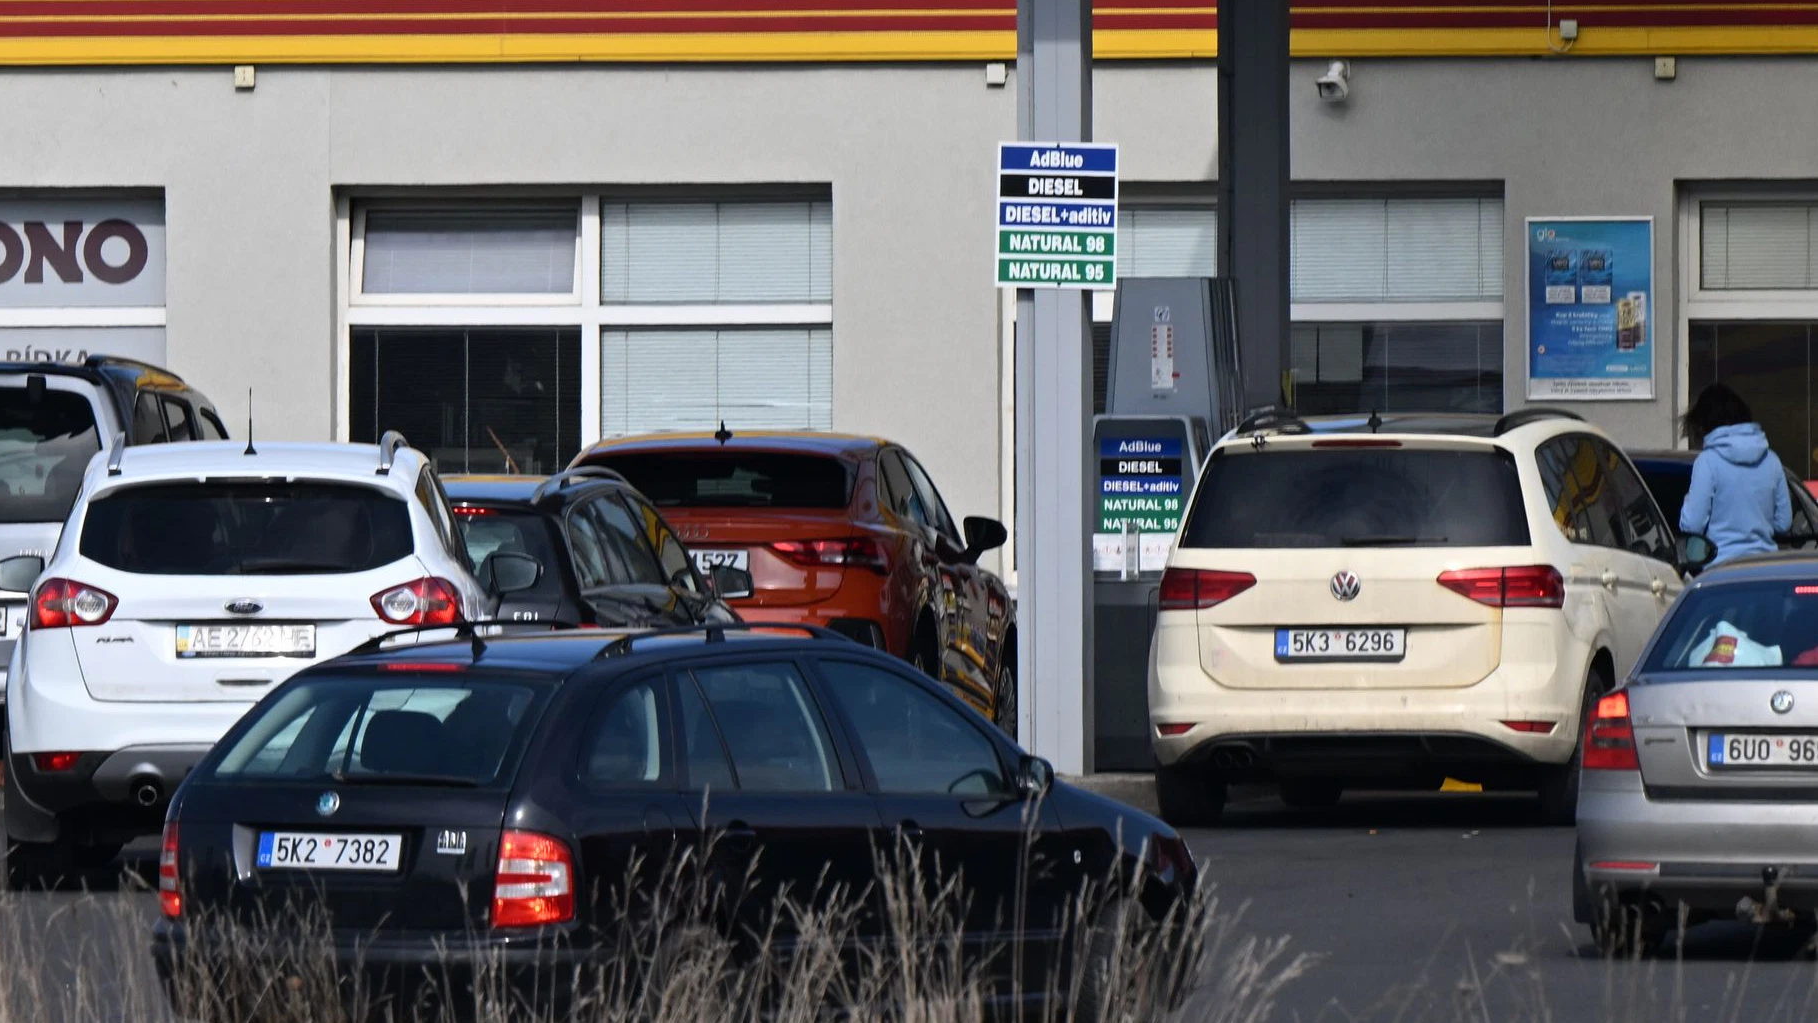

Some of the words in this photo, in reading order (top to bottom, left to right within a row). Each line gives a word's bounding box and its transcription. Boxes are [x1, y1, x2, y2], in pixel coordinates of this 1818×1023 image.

[1030, 149, 1084, 169] AdBlue
[1028, 177, 1084, 196] DIESEL
[1009, 233, 1082, 252] NATURAL
[1086, 235, 1105, 253] 98
[1008, 261, 1081, 281] NATURAL
[1085, 263, 1104, 281] 95
[1119, 440, 1162, 453] AdBlue
[1118, 460, 1163, 473] DIESEL
[1104, 498, 1162, 511] NATURAL
[1164, 498, 1179, 511] 98
[1292, 631, 1331, 653] 5K3
[1345, 631, 1395, 653] 6296
[1728, 738, 1771, 761] 6U0
[1788, 738, 1818, 762] 96
[276, 836, 318, 864] 5K2
[334, 838, 391, 865] 7382
